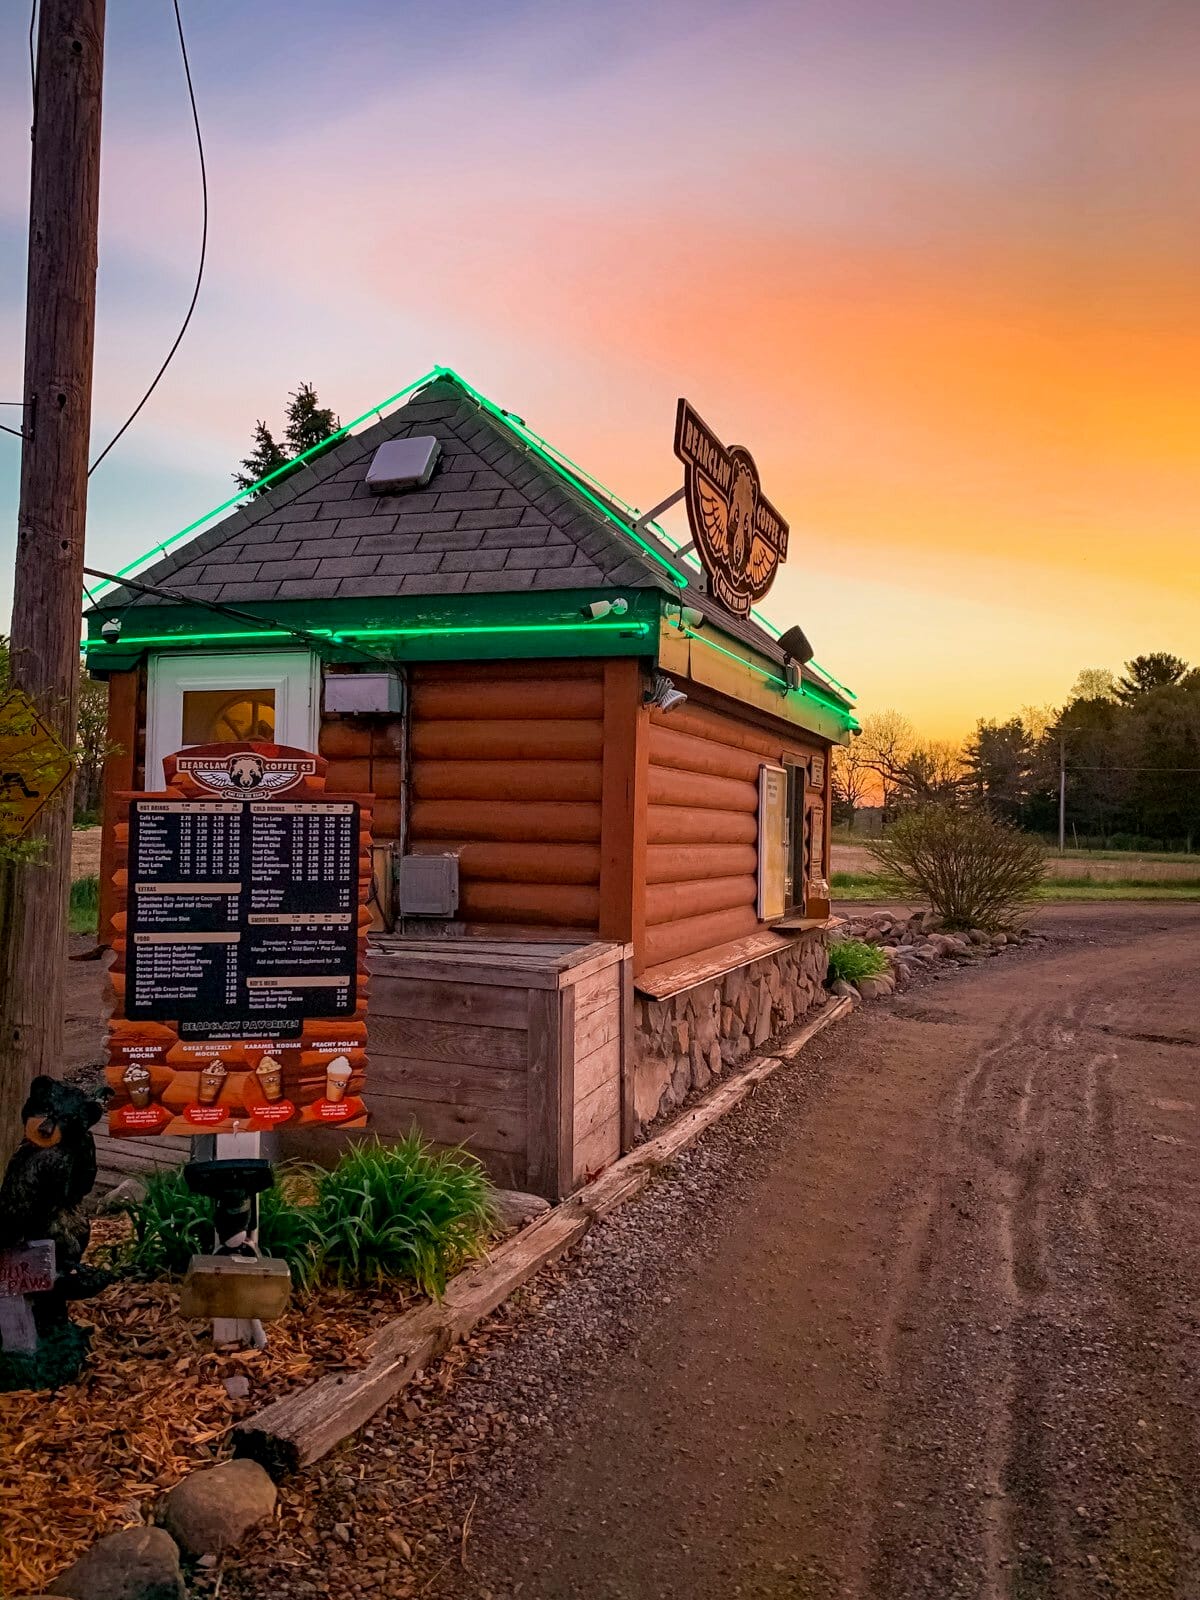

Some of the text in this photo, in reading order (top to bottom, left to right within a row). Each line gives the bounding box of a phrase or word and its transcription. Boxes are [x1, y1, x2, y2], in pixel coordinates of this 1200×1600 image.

[685, 419, 731, 491] BEARCLAW
[756, 504, 779, 545] COFFEE
[181, 762, 228, 770] BEARCLAW
[183, 1022, 240, 1031] BEARCLAW
